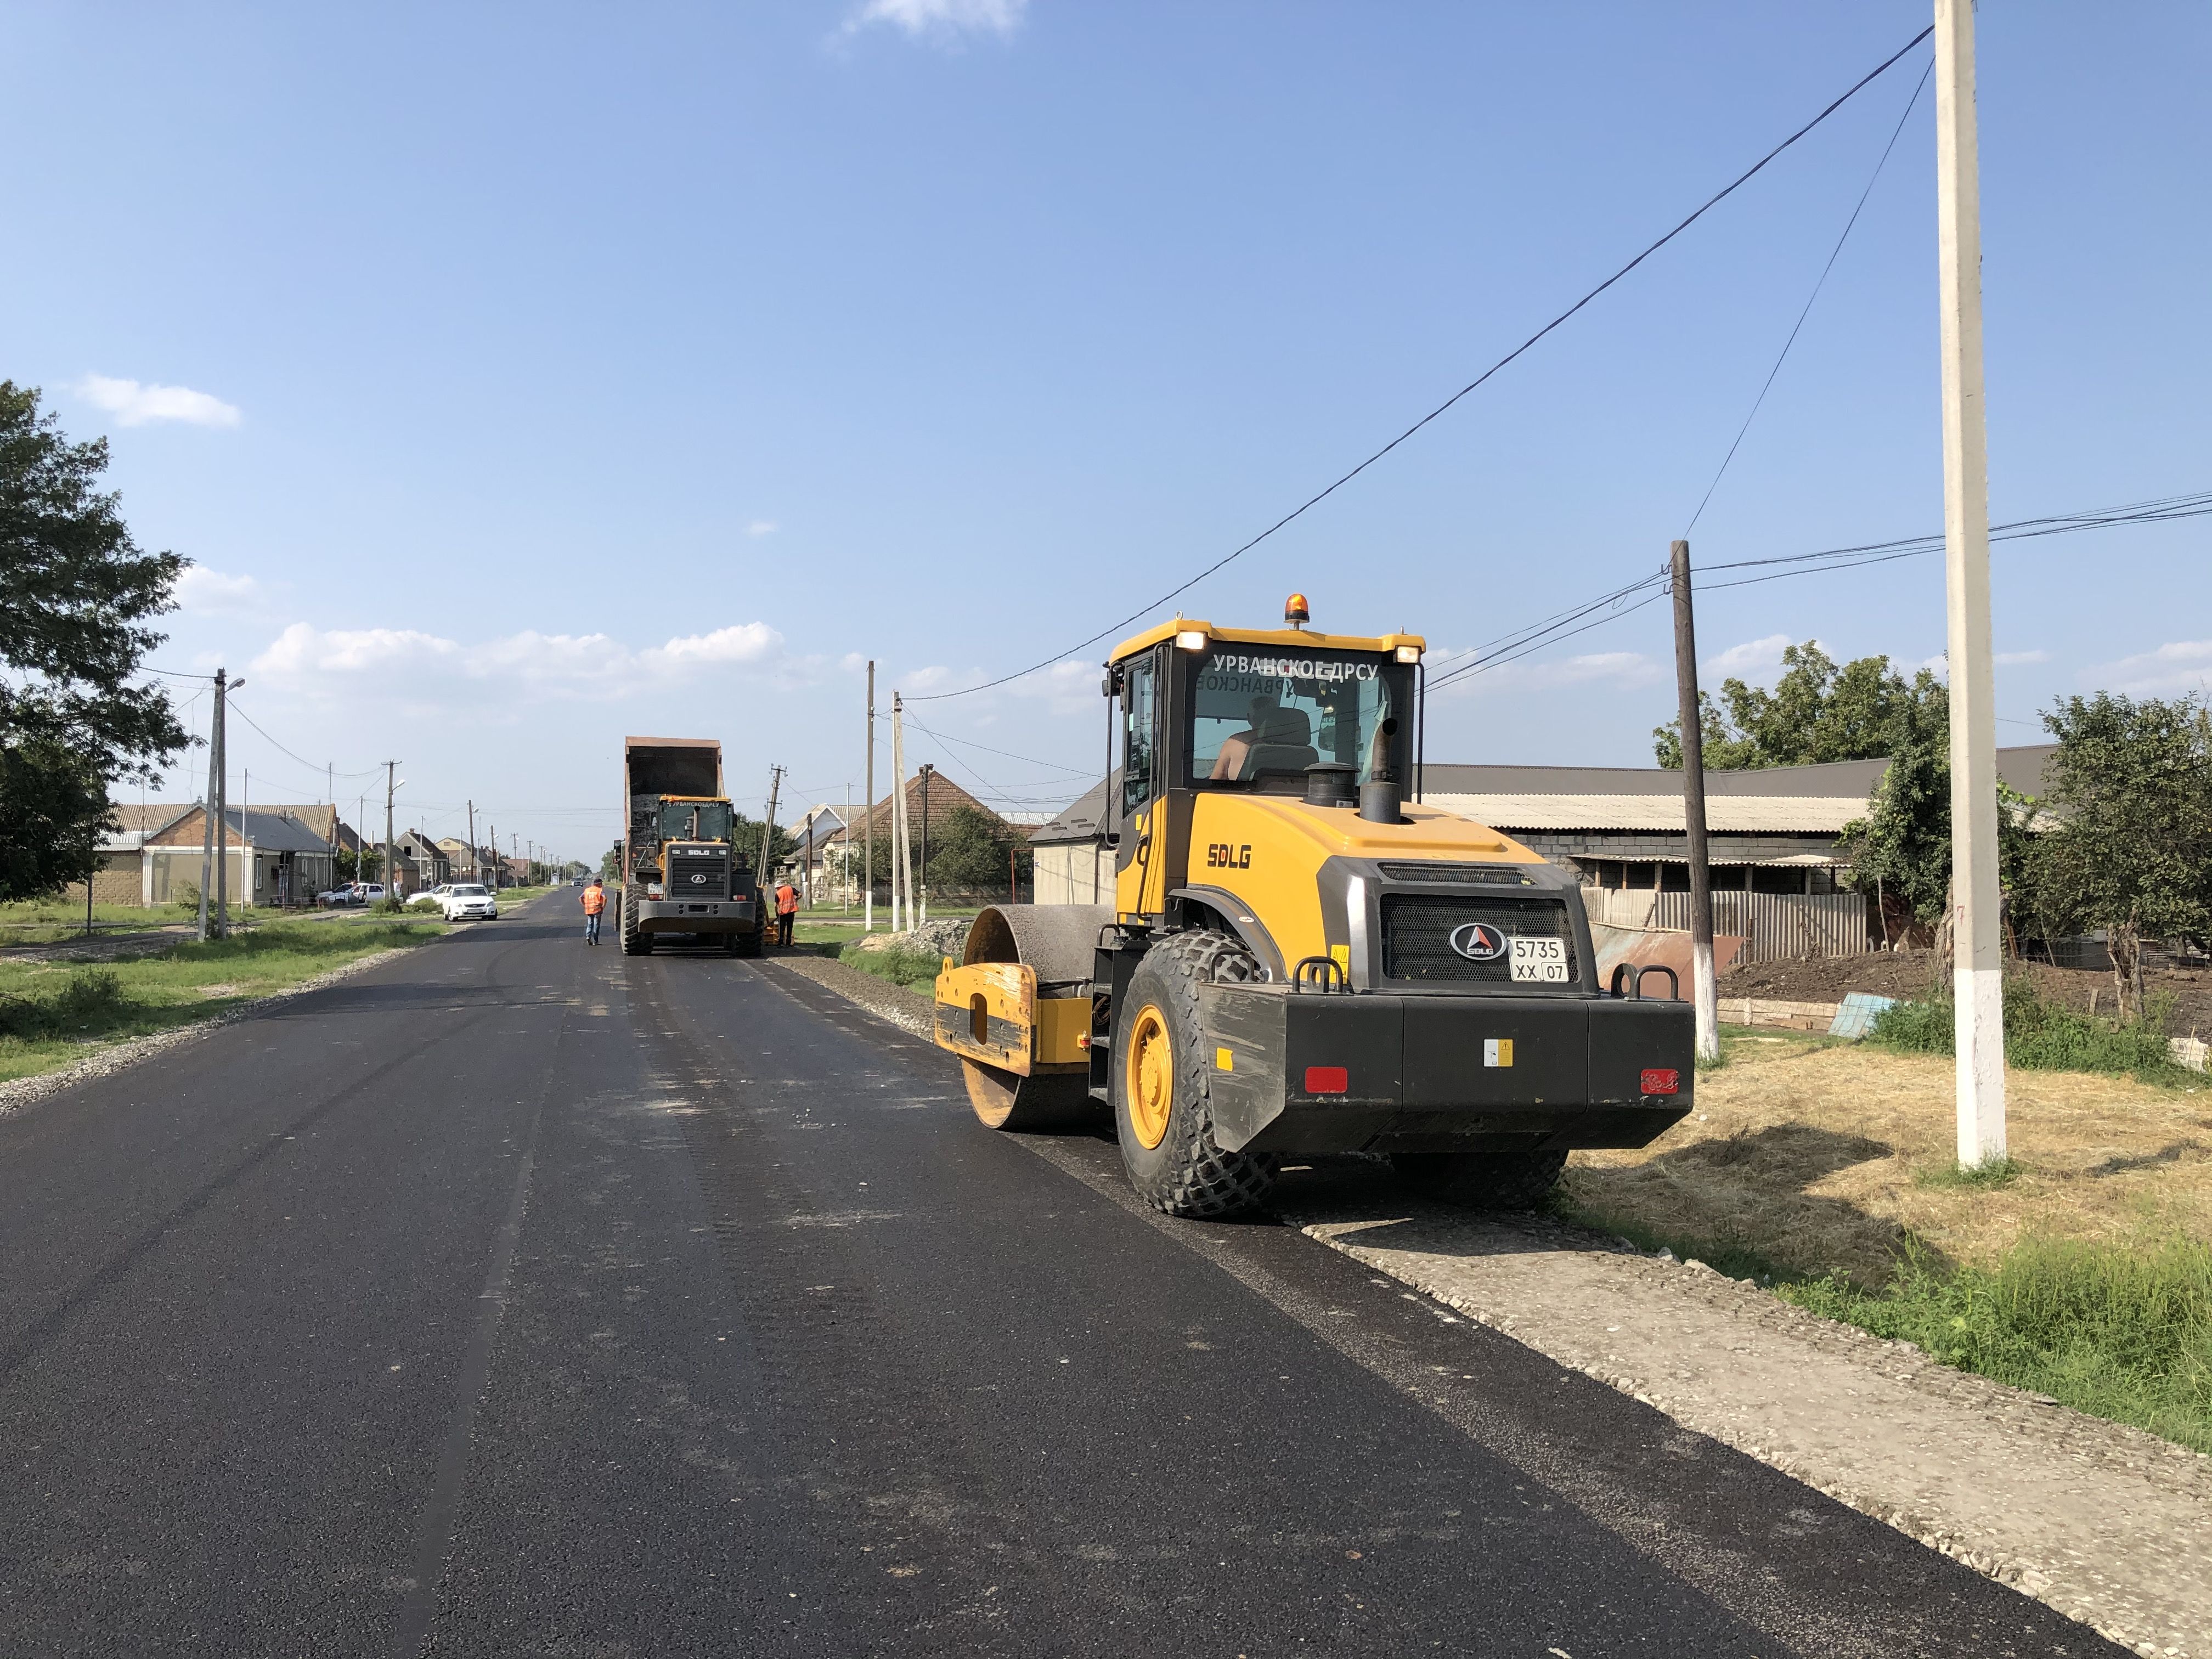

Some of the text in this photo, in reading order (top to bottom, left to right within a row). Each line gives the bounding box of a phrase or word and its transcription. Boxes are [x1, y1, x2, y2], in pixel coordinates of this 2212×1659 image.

[1207, 844, 1251, 870] SDLG
[1956, 905, 1965, 927] 7
[1516, 941, 1559, 958] 5735
[1547, 966, 1563, 979] 07
